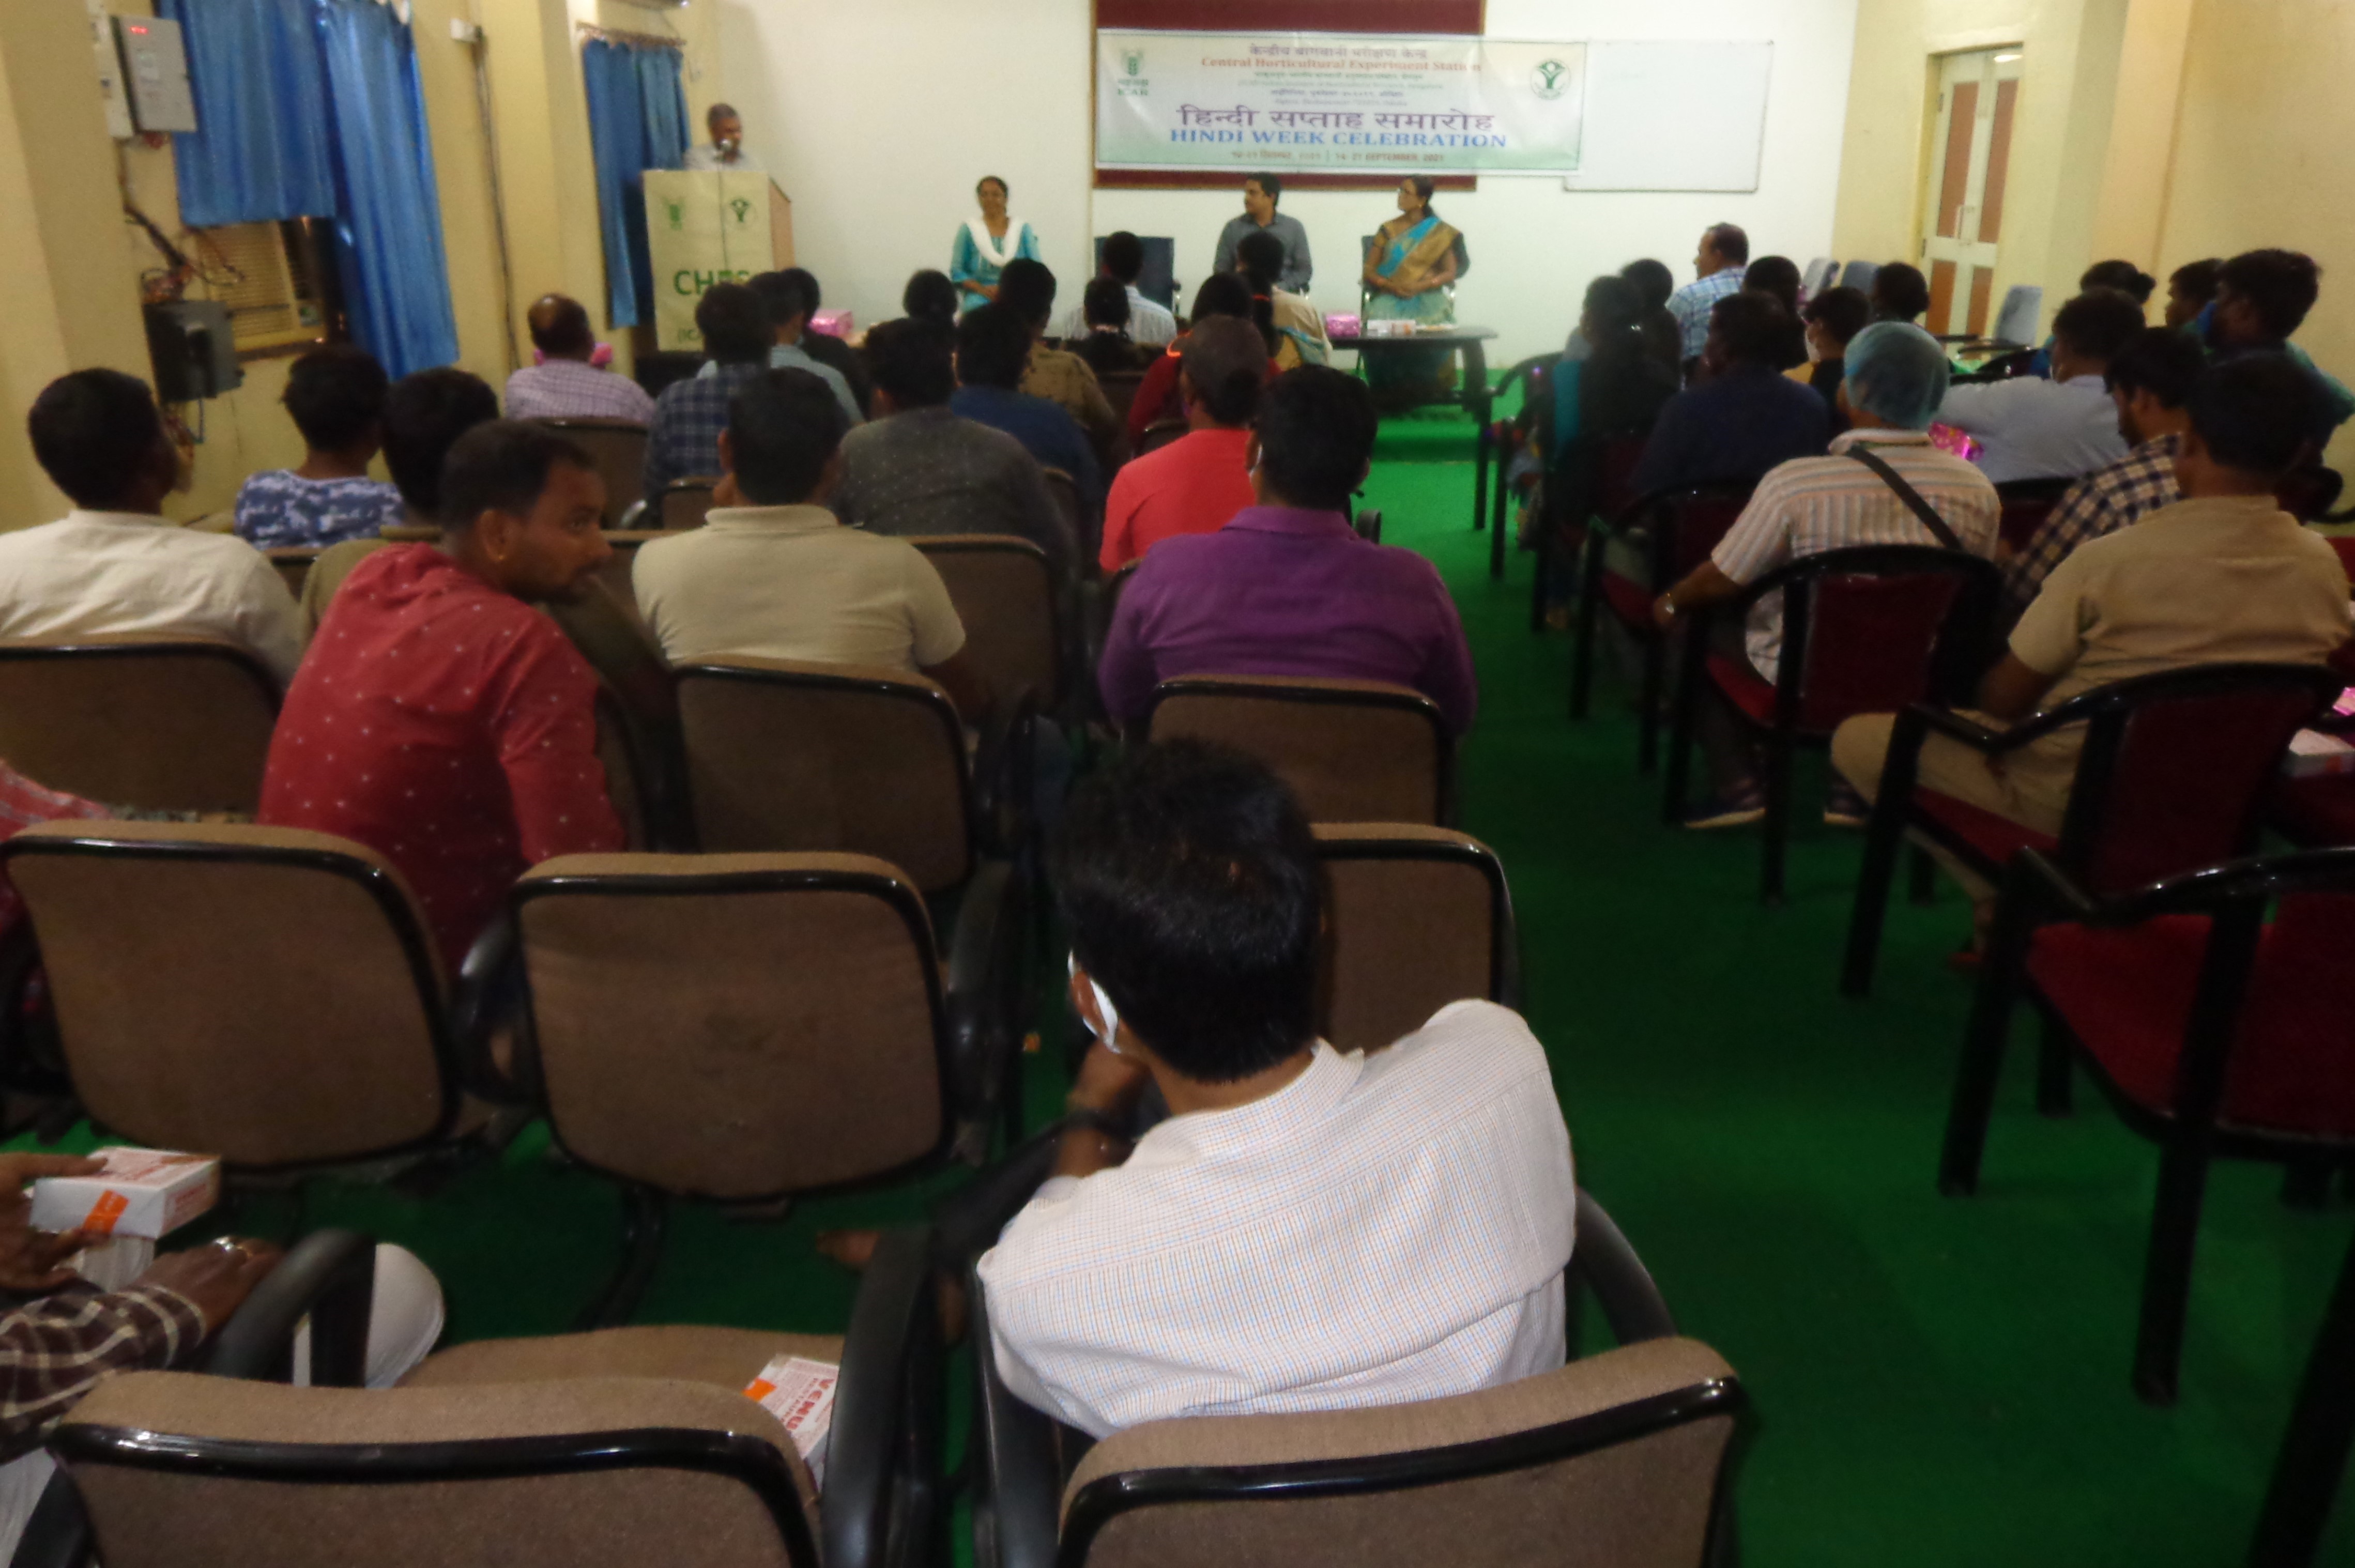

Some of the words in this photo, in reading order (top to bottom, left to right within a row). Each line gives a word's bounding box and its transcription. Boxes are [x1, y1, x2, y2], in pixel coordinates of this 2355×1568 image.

[1201, 57, 1251, 67] Central
[1256, 58, 1344, 68] Horticultural
[1350, 59, 1429, 71] Experiment
[1433, 62, 1481, 71] Statin
[1176, 104, 1260, 127] हिन्दी
[1269, 111, 1364, 129] सप्ताह
[1373, 108, 1495, 131] समारोह
[1171, 129, 1243, 142] HINDI
[1252, 130, 1325, 144] WEEK
[1333, 132, 1506, 147] CELEBRATION
